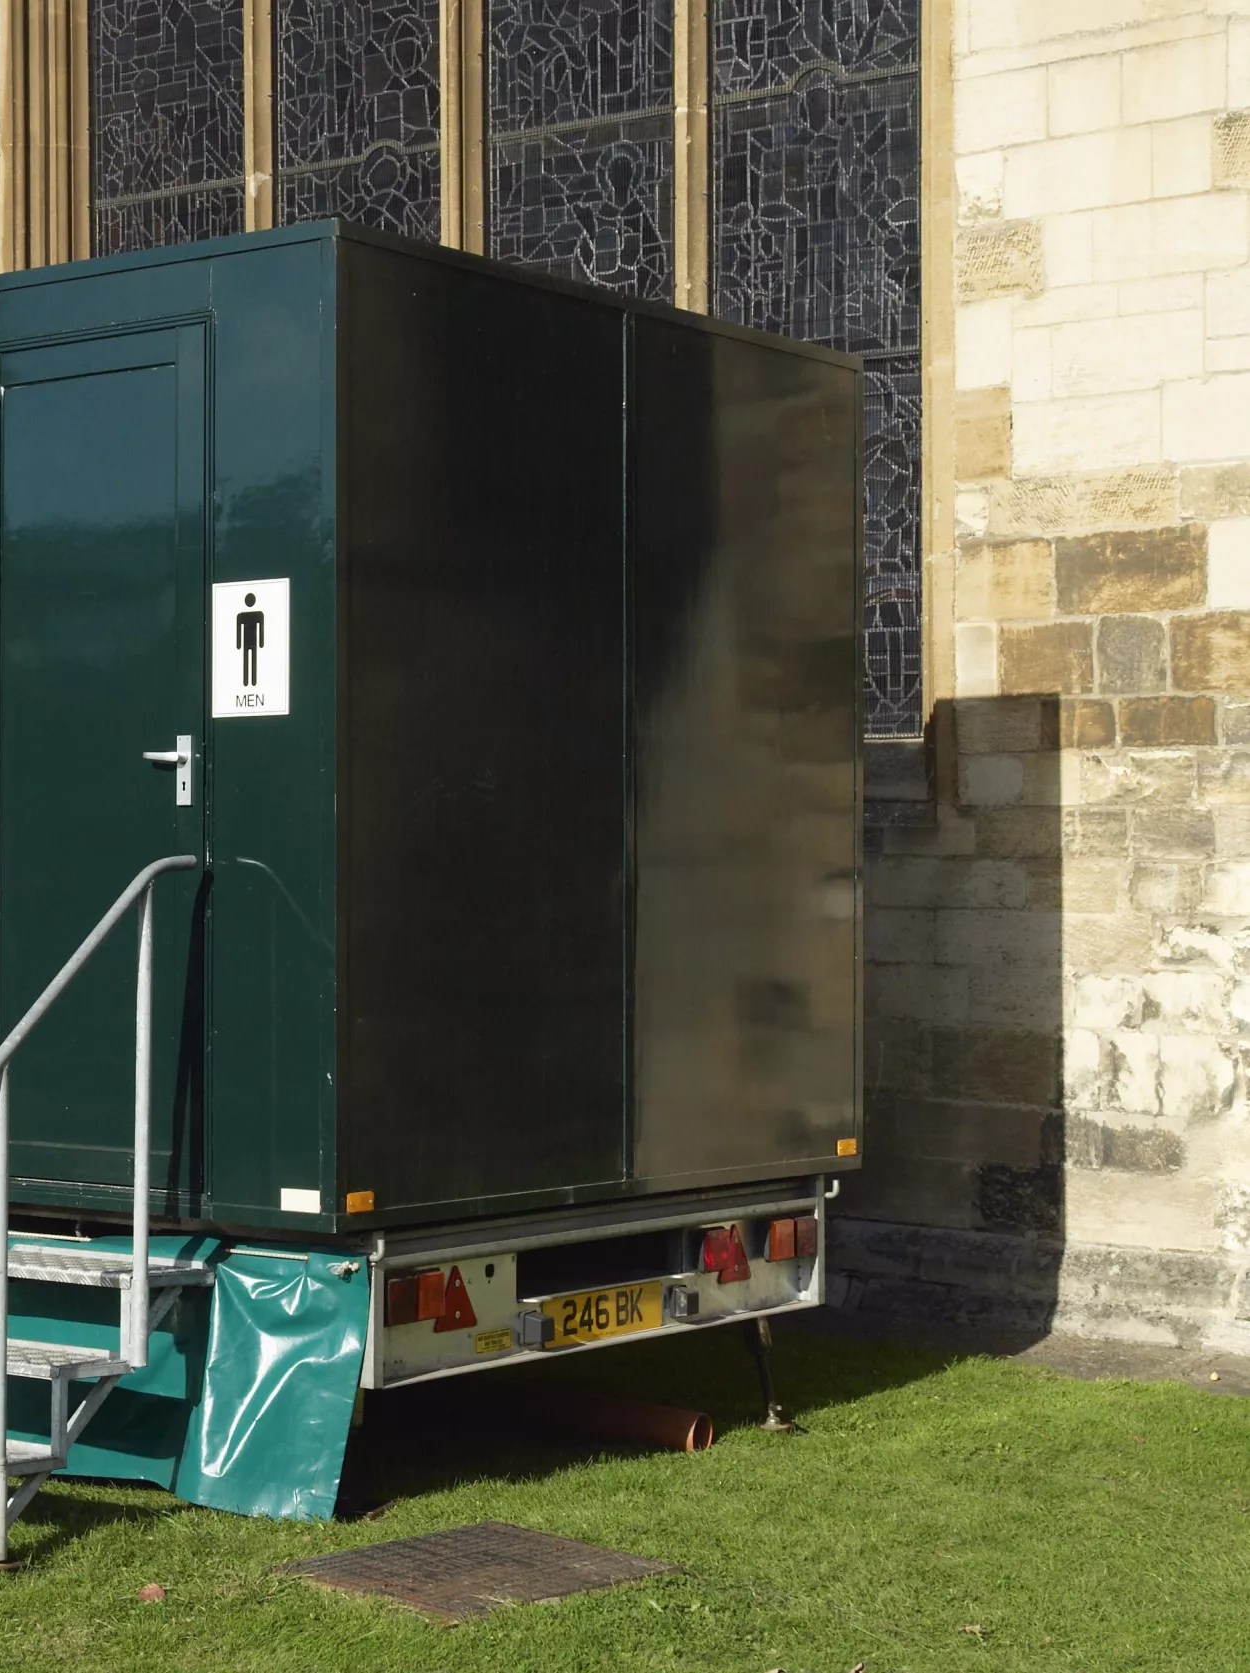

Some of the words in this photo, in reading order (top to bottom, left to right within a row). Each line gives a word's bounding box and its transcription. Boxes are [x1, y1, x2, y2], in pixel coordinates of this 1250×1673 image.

[235, 693, 265, 708] MEN
[562, 1294, 610, 1337] 246
[616, 1287, 643, 1327] BK
